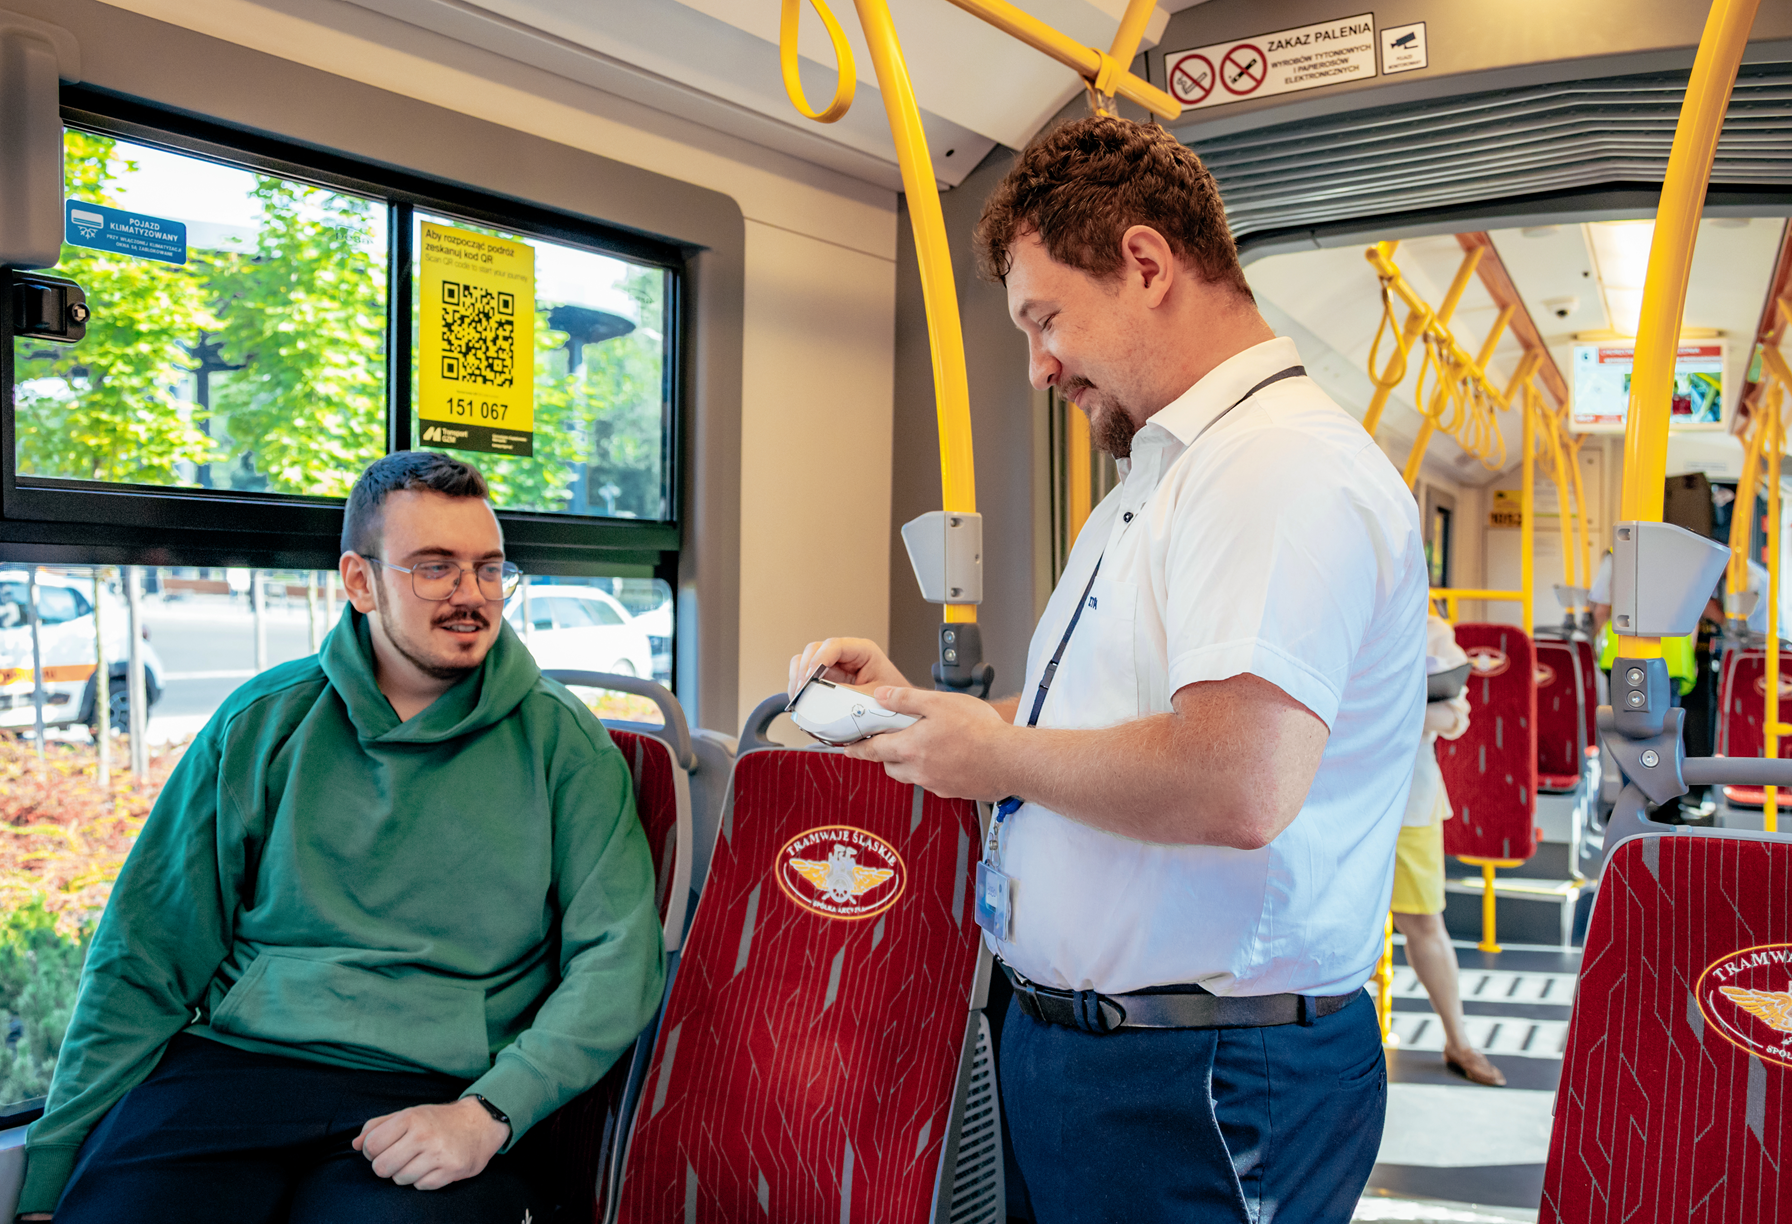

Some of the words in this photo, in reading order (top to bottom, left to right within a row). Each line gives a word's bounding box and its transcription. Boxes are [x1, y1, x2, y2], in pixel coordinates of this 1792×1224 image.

[1267, 34, 1311, 52] ZAKAZ
[1314, 22, 1372, 43] PALENIA
[1271, 55, 1312, 69] WYROBÓW
[1315, 43, 1372, 60] TYTONIOWYCH
[1284, 65, 1360, 84] ELEKTRONICZNYCH
[110, 222, 178, 242] KLIMATYZOWANY
[129, 218, 161, 230] POJAZD
[425, 229, 442, 242] Aby
[444, 234, 486, 251] rozpocząć
[487, 244, 515, 257] podróż
[425, 243, 462, 259] zeskanuj
[464, 249, 479, 261] kod
[480, 254, 493, 264] QR
[425, 253, 442, 264] Scan
[443, 257, 453, 267] QR
[454, 260, 470, 270] code
[471, 263, 478, 271] to
[479, 265, 492, 274] start
[494, 269, 506, 278] your
[446, 397, 473, 417] 151
[481, 401, 508, 421] 067
[786, 830, 850, 857] TRAMWAJE
[852, 830, 897, 866] ŚLĄSKIE
